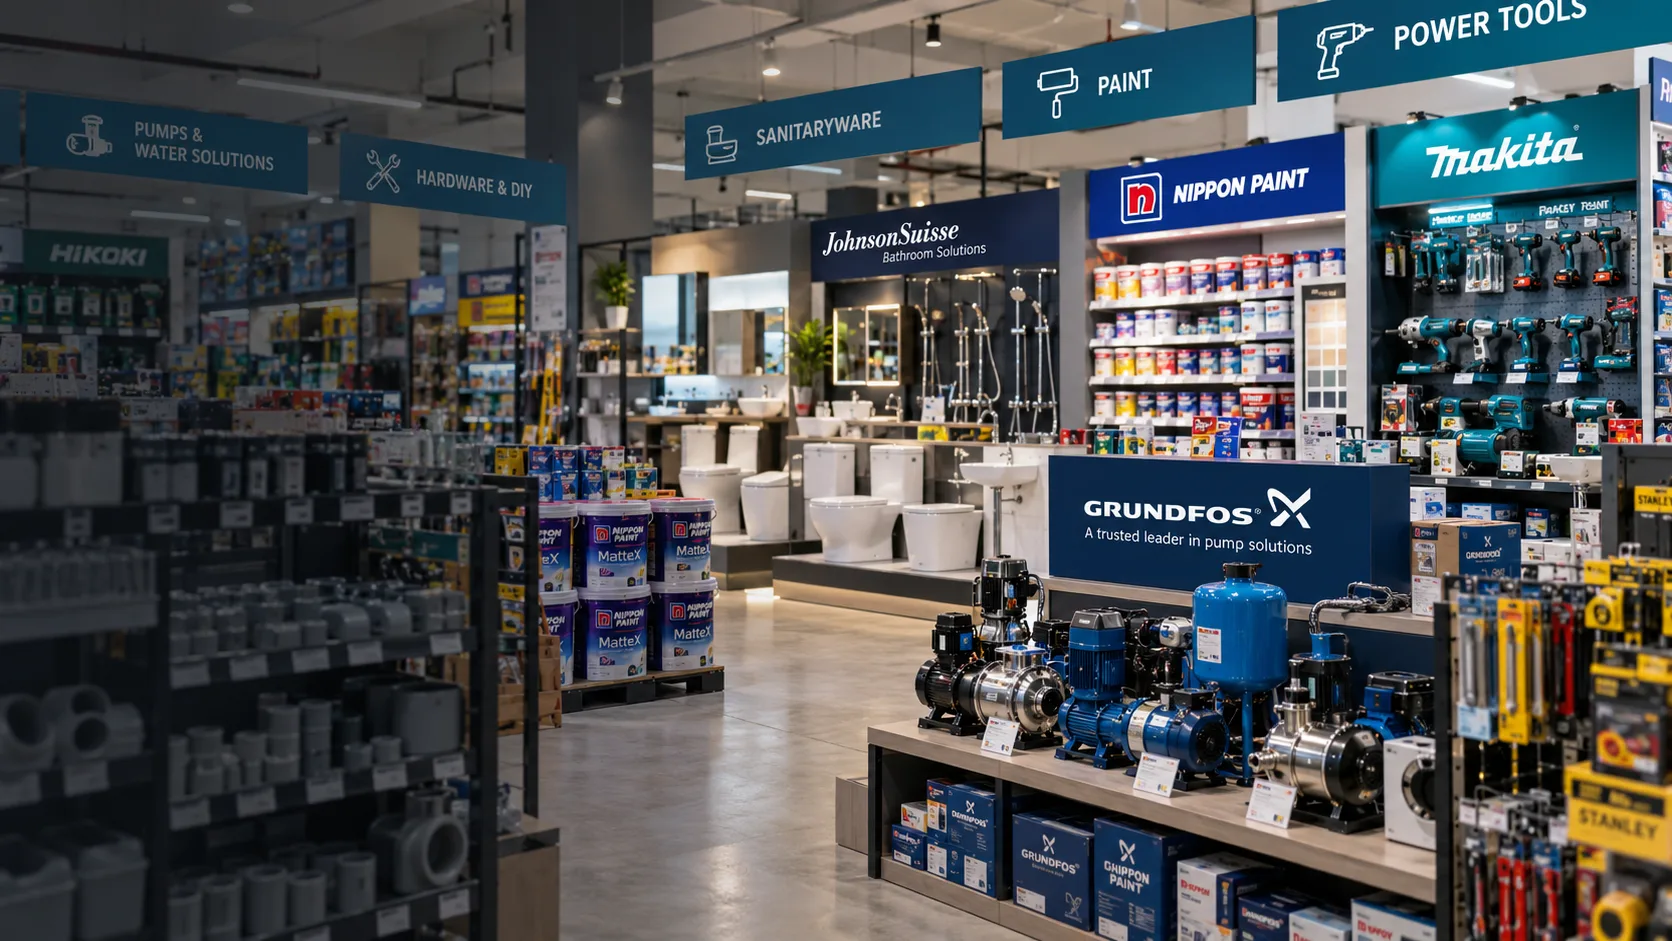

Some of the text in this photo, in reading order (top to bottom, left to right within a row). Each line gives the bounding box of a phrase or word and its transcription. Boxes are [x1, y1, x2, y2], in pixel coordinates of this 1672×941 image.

[1394, 0, 1588, 50] POWER TOOLS
[1098, 68, 1153, 96] PAINT
[134, 121, 204, 143] PUMPS &
[756, 110, 882, 146] SANITARYWARE
[134, 143, 275, 172] WATER SOLUTIONS
[416, 169, 533, 199] HARDWARE & DIY
[1173, 176, 1246, 204] NIPPON
[1250, 168, 1310, 194] PAINT
[822, 220, 960, 256] JohnsonSuisse
[882, 243, 987, 263] Bathroom Solutions
[1638, 494, 1672, 507] STANLE
[614, 534, 639, 542] PAINT
[1084, 526, 1312, 555] A trusted leader in pump solutions
[598, 548, 642, 563] MatteX
[615, 617, 640, 627] PAINT
[673, 626, 712, 641] MatteX
[598, 634, 642, 649] MatteX
[1579, 807, 1658, 841] STANLEY
[1109, 873, 1144, 895] PAINT
